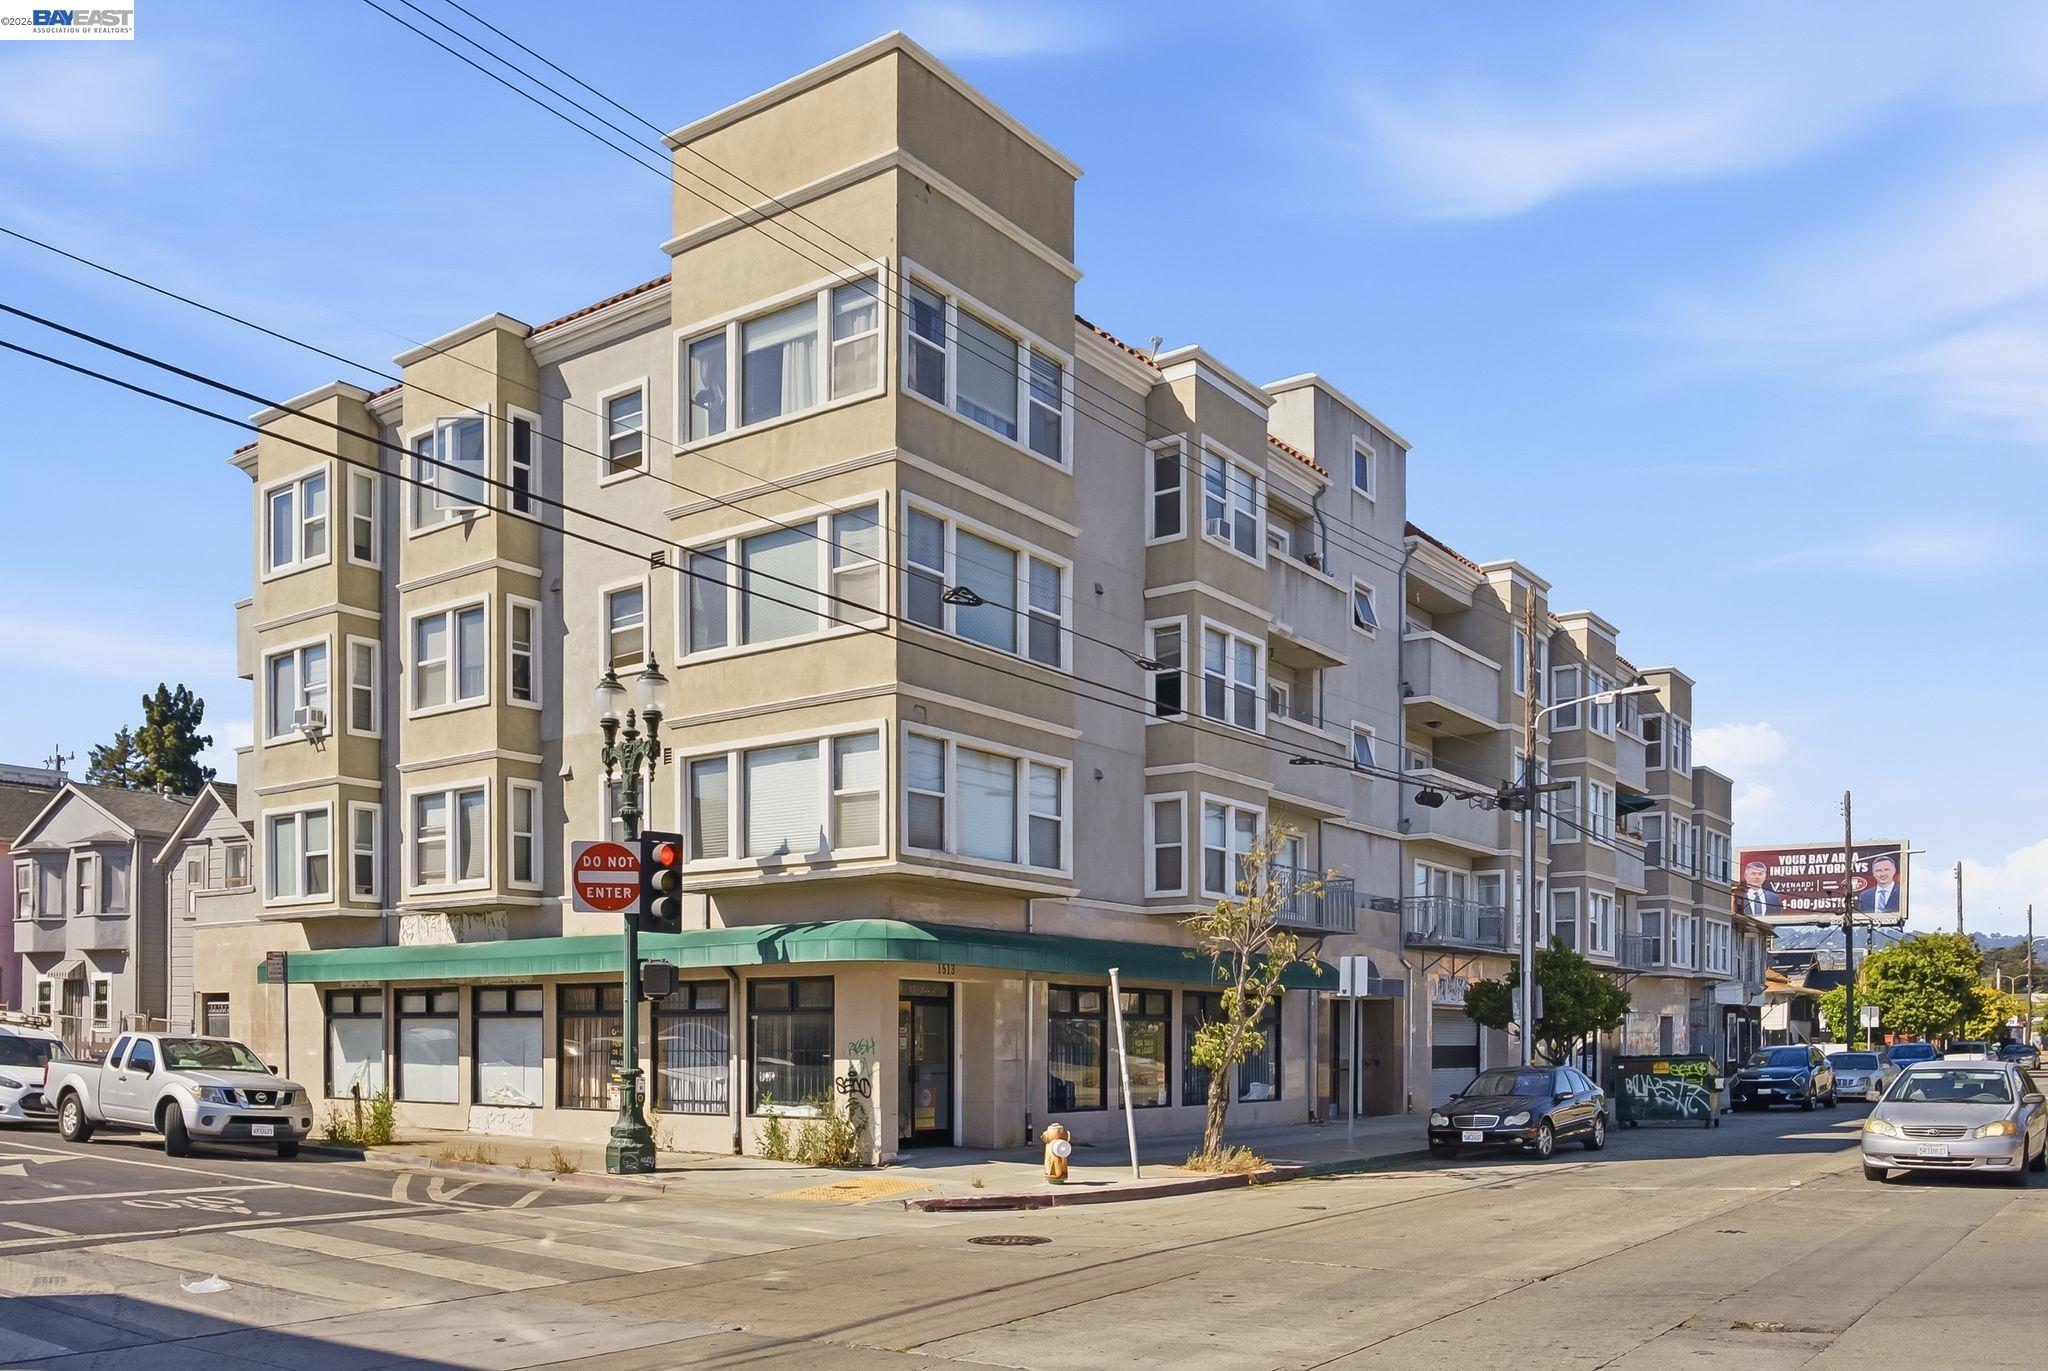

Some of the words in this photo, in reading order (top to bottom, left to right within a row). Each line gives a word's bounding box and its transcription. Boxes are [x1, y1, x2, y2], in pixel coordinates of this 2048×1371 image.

[583, 855, 601, 868] DO
[608, 856, 634, 868] NOT
[1778, 855, 1806, 865] YOUR
[1808, 853, 1829, 864] BAY
[1831, 852, 1859, 863] ARA
[1770, 865, 1806, 877] INJURY
[1807, 862, 1869, 874] ATTORNYS
[586, 887, 632, 899] ENTER
[937, 963, 955, 975] 1513
